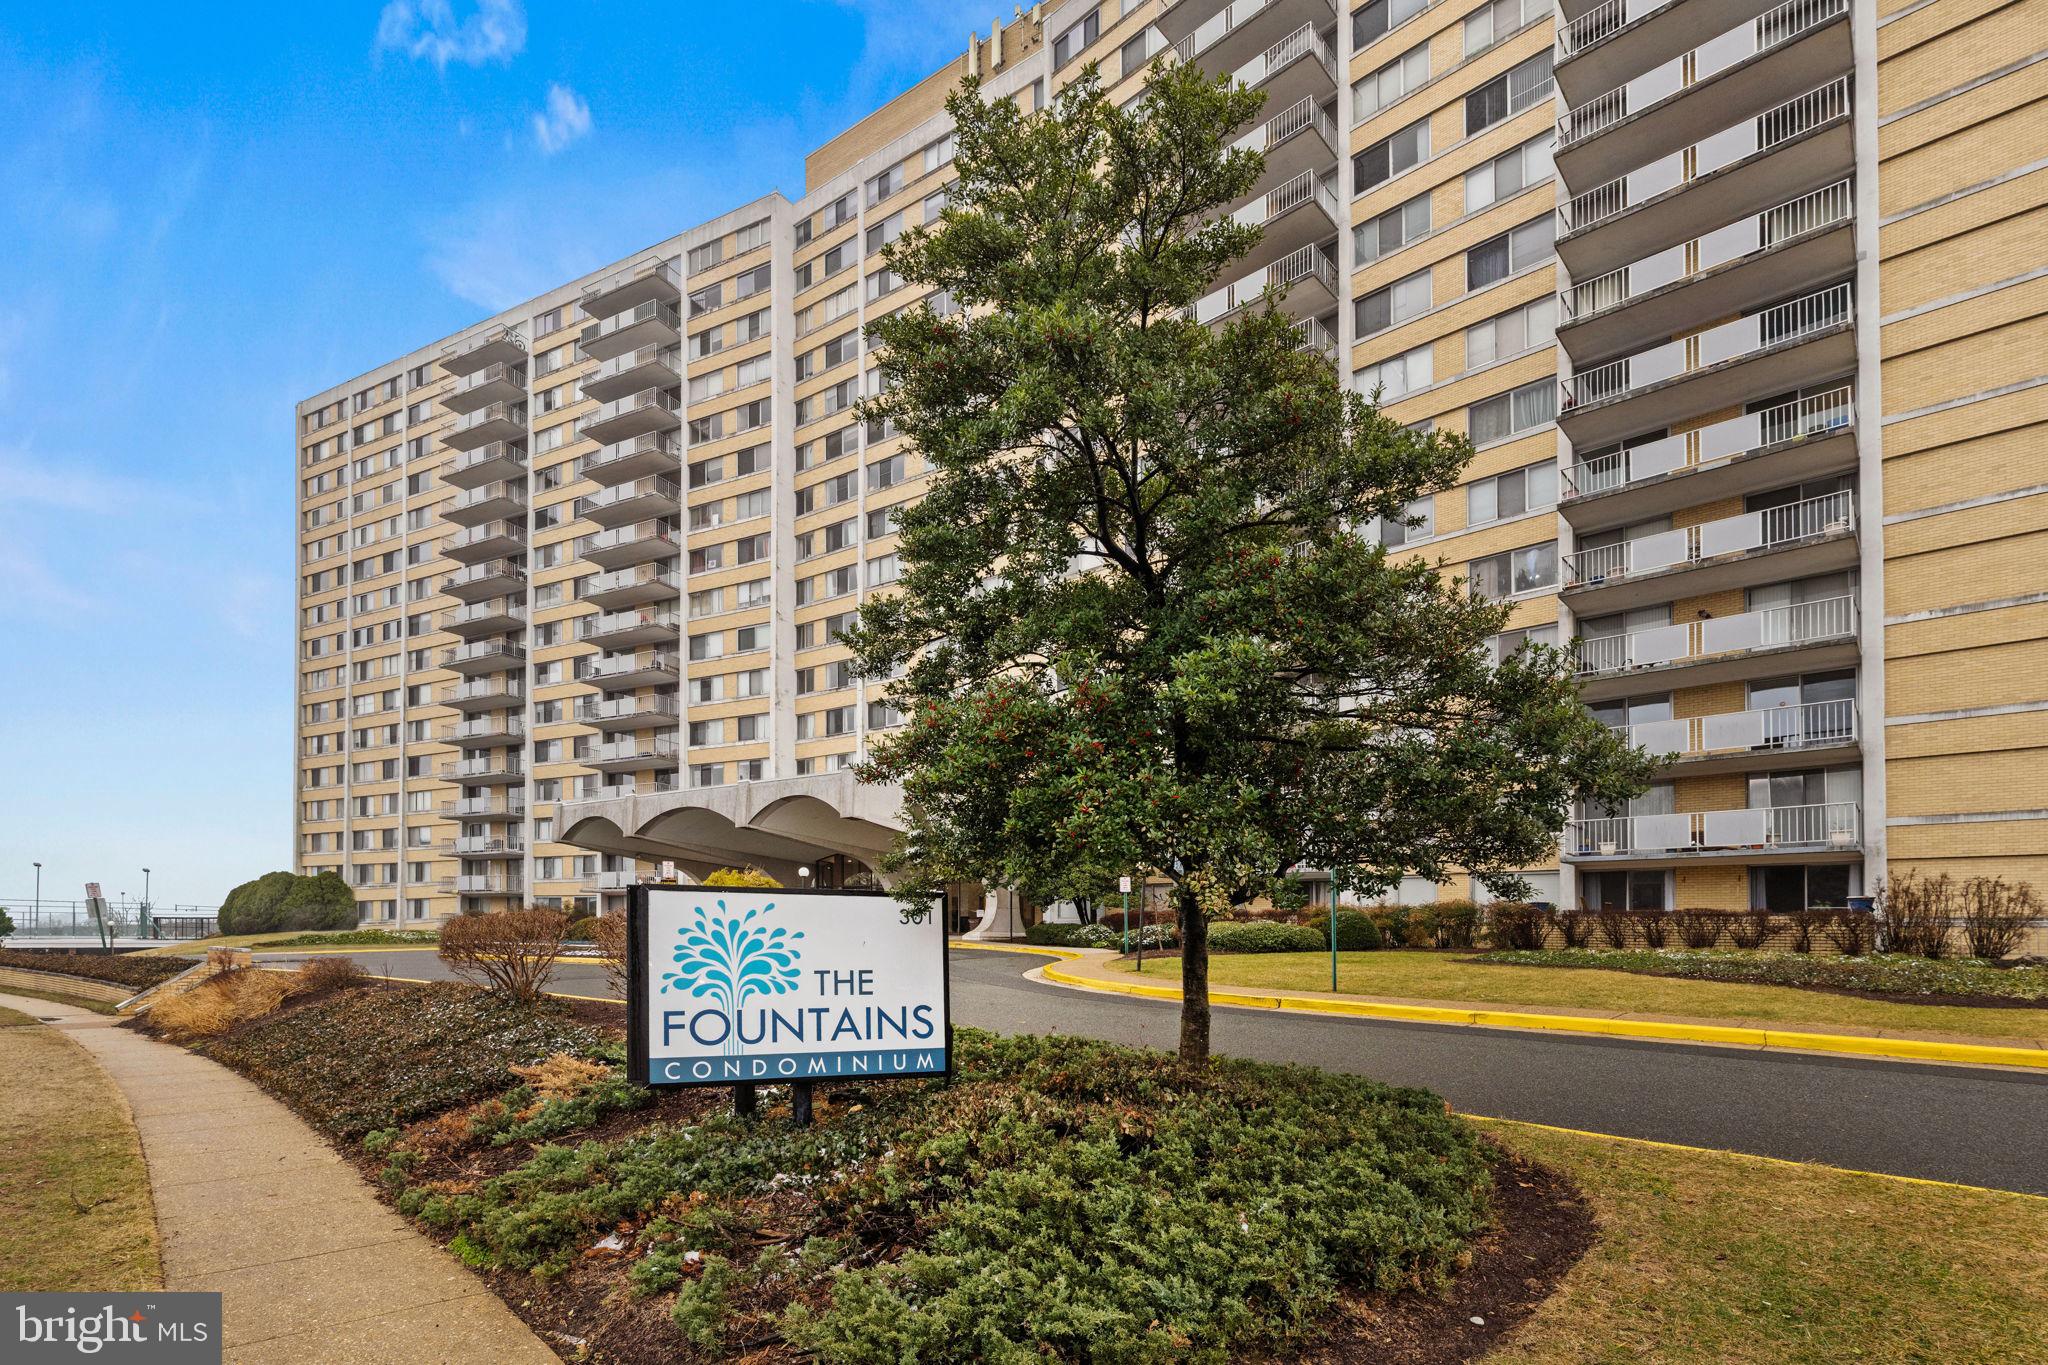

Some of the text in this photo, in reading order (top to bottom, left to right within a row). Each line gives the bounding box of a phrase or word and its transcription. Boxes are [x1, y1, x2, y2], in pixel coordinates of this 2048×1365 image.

[900, 909, 932, 924] 301
[814, 970, 873, 996] THE
[663, 1004, 934, 1046] FOUNTAINS
[664, 1053, 934, 1080] CONDOMINIUM
